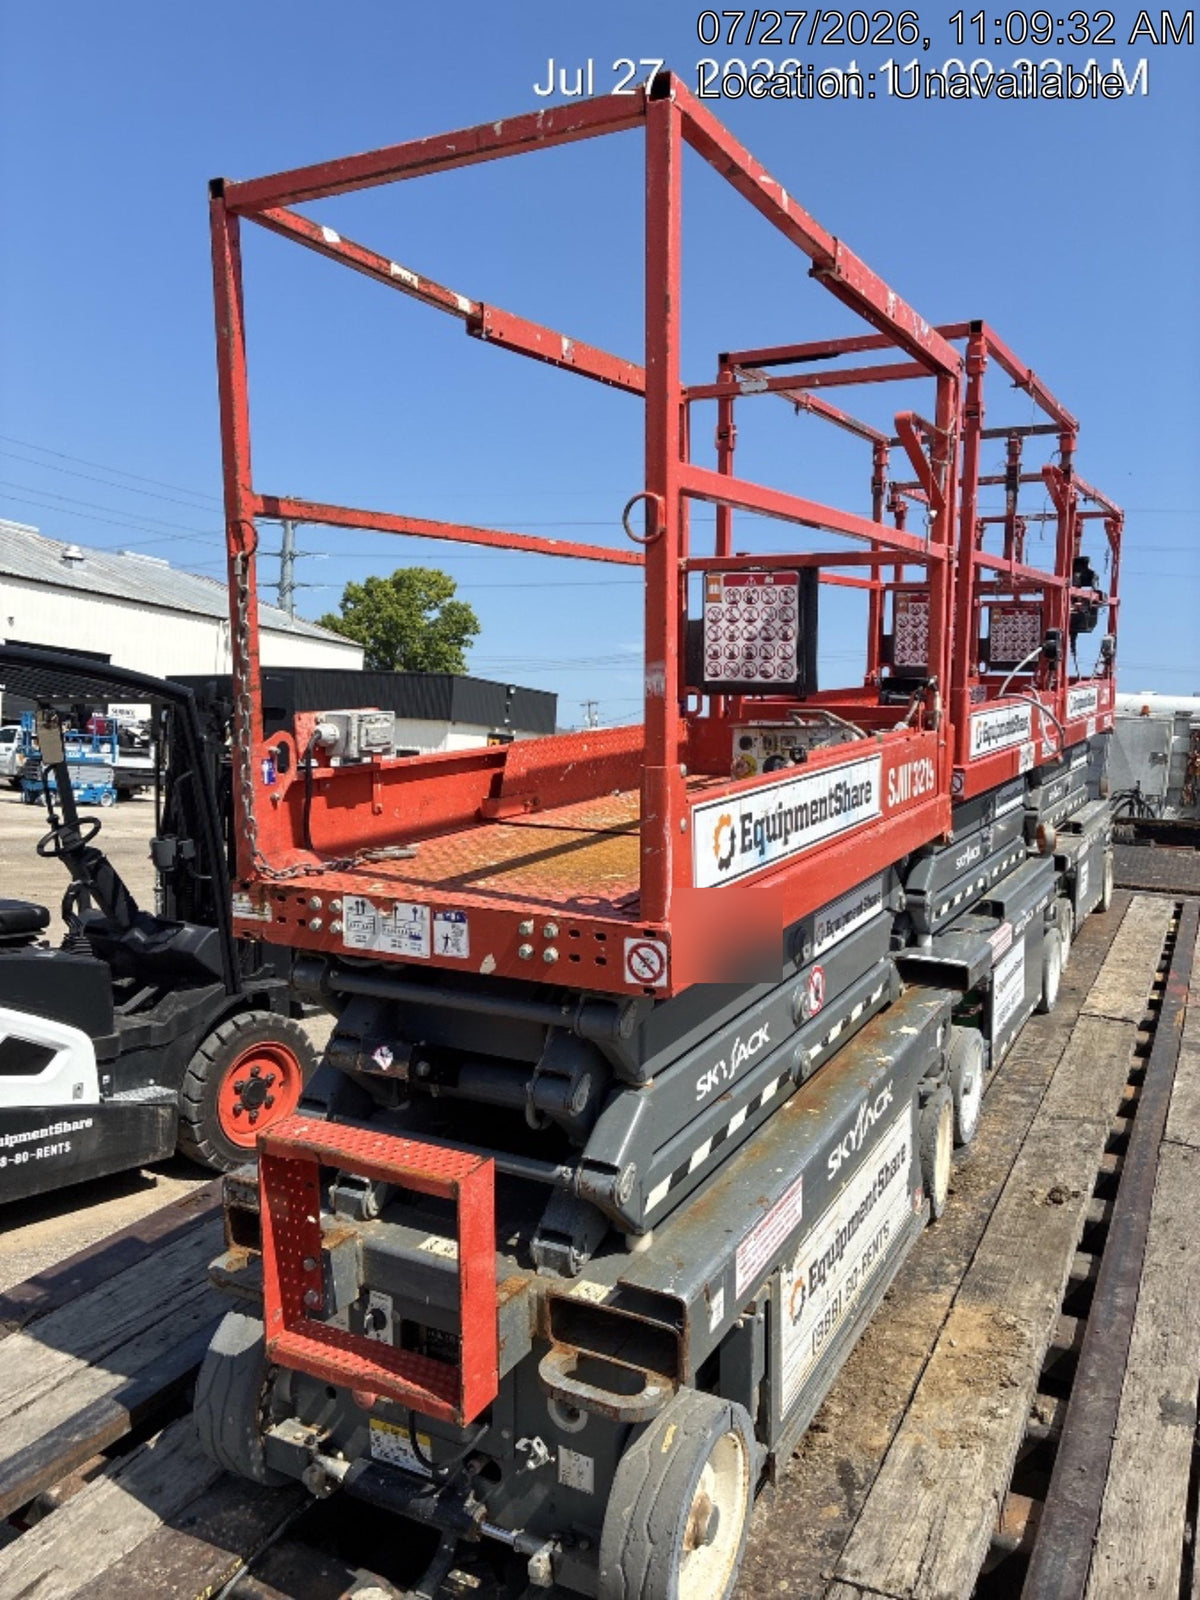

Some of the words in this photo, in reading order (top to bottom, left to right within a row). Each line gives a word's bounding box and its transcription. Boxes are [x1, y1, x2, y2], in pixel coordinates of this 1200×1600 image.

[740, 779, 873, 856] EquipmentShare
[696, 1022, 771, 1101] SKYJACK
[827, 1079, 894, 1181] SKYJACK
[808, 1143, 906, 1298] EquipmentShare
